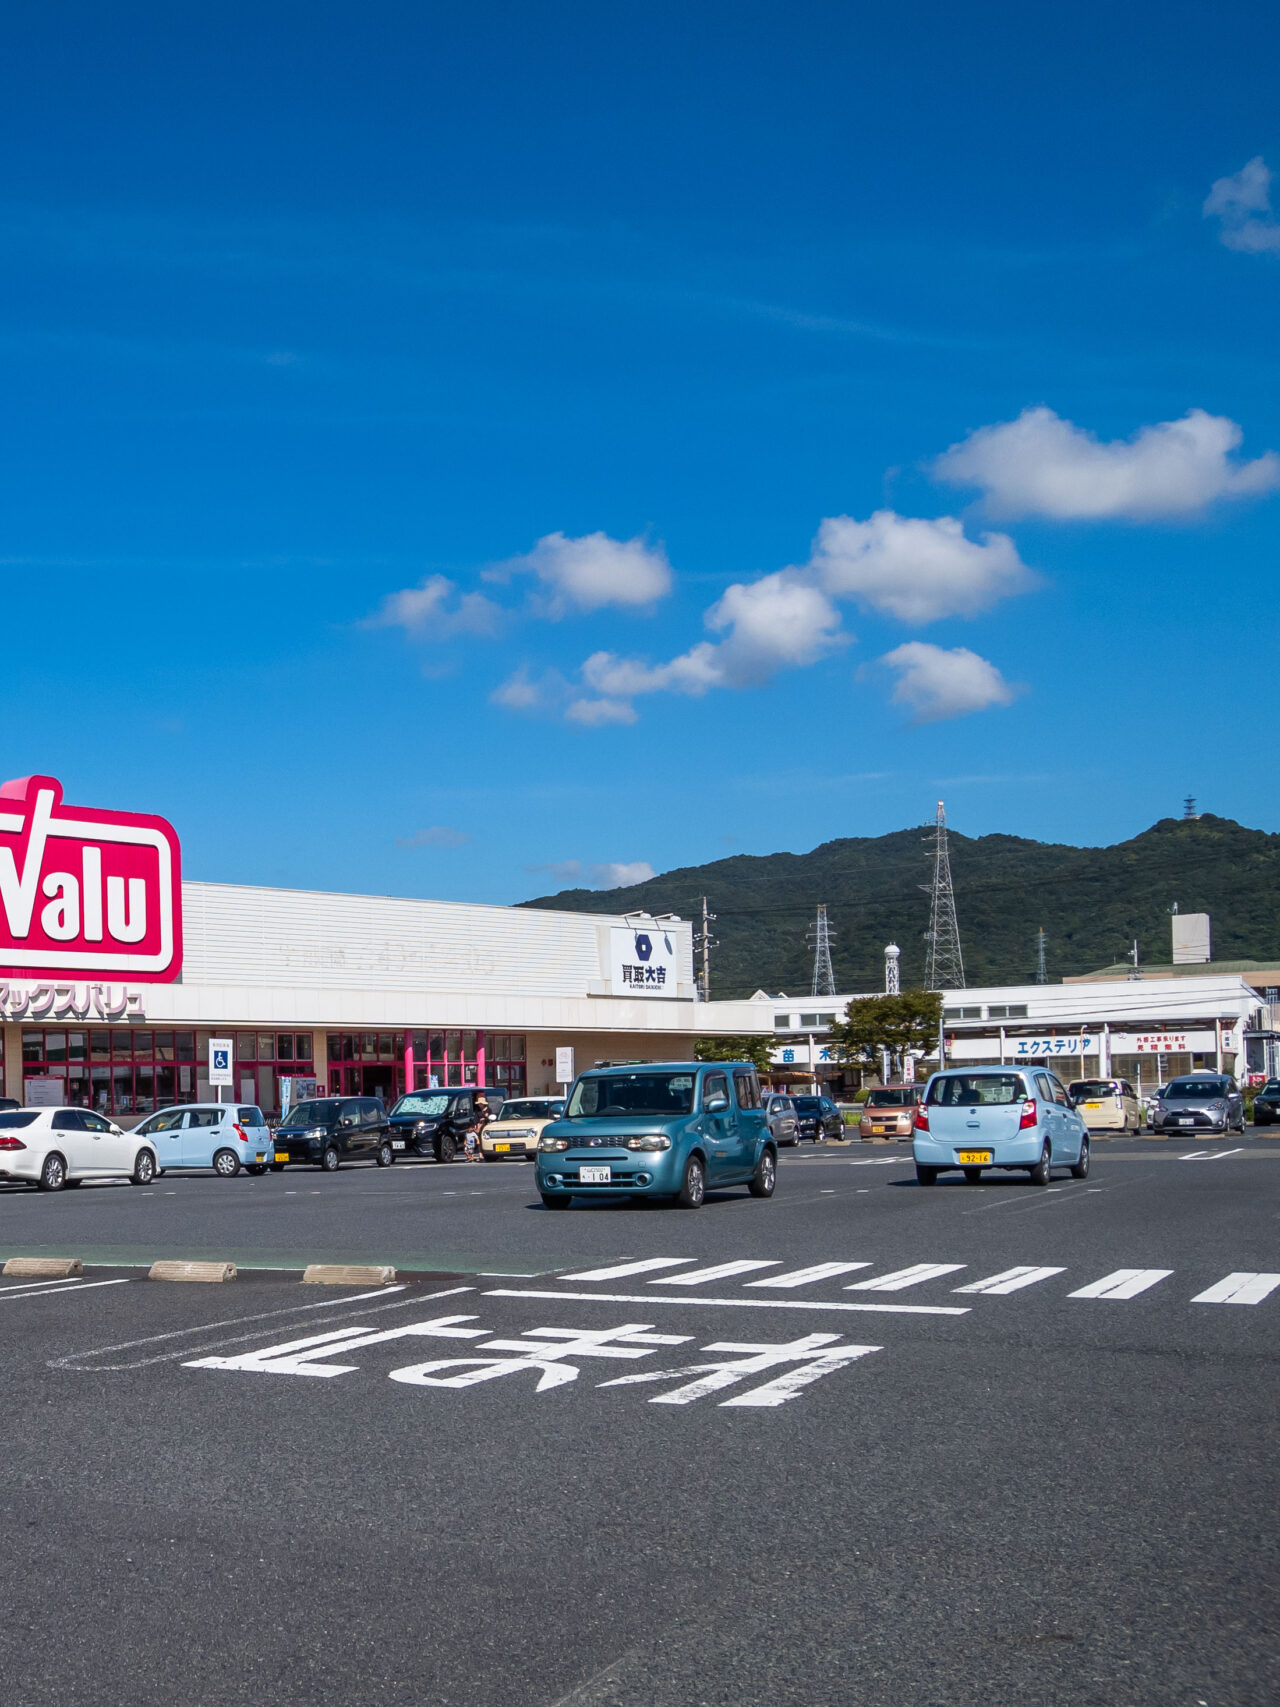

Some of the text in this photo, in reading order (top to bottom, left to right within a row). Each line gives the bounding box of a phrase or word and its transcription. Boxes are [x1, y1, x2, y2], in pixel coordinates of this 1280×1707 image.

[622, 964, 667, 985] 買取大吉
[1017, 1038, 1091, 1055] エクステリア
[180, 1314, 885, 1408] 止まれ
